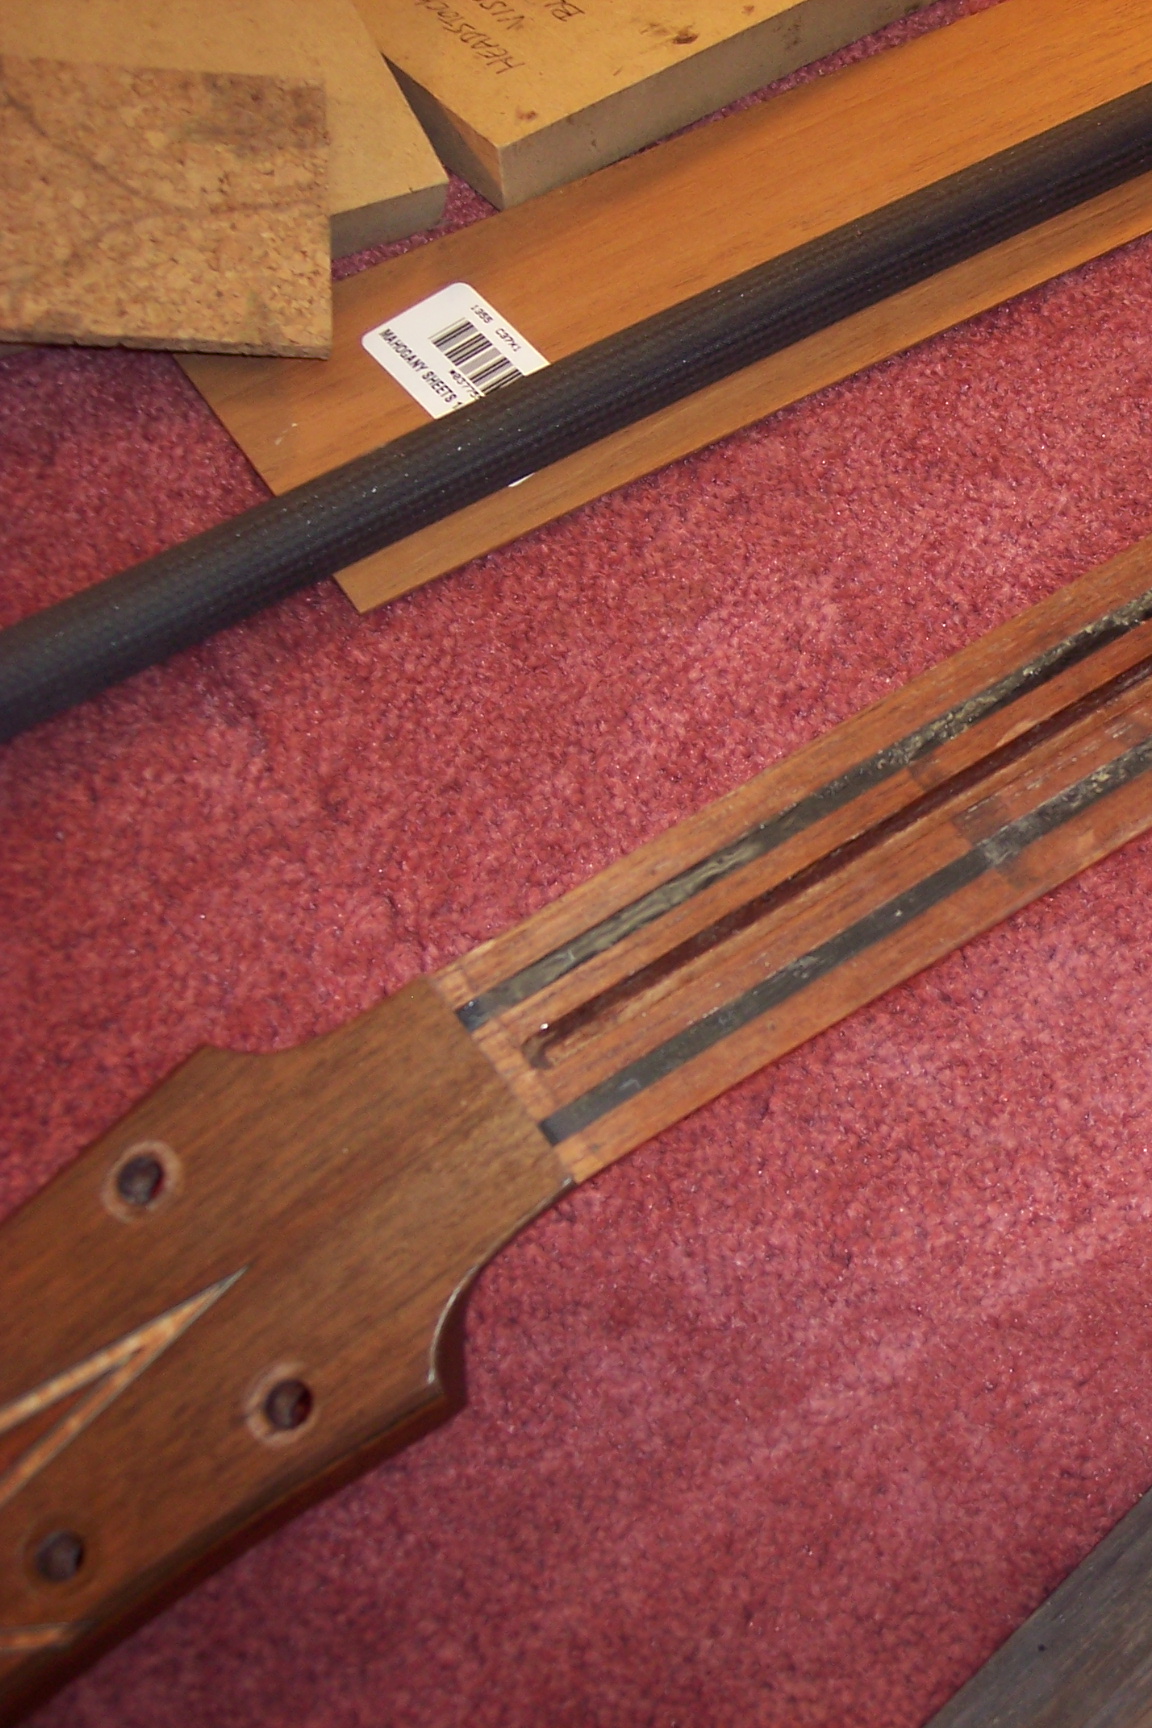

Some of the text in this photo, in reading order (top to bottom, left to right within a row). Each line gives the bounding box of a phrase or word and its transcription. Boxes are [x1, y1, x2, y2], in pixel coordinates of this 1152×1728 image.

[472, 0, 525, 30] VIS
[470, 304, 494, 325] 1355
[378, 328, 428, 372] MAHOGANY
[421, 371, 458, 403] SHEETS
